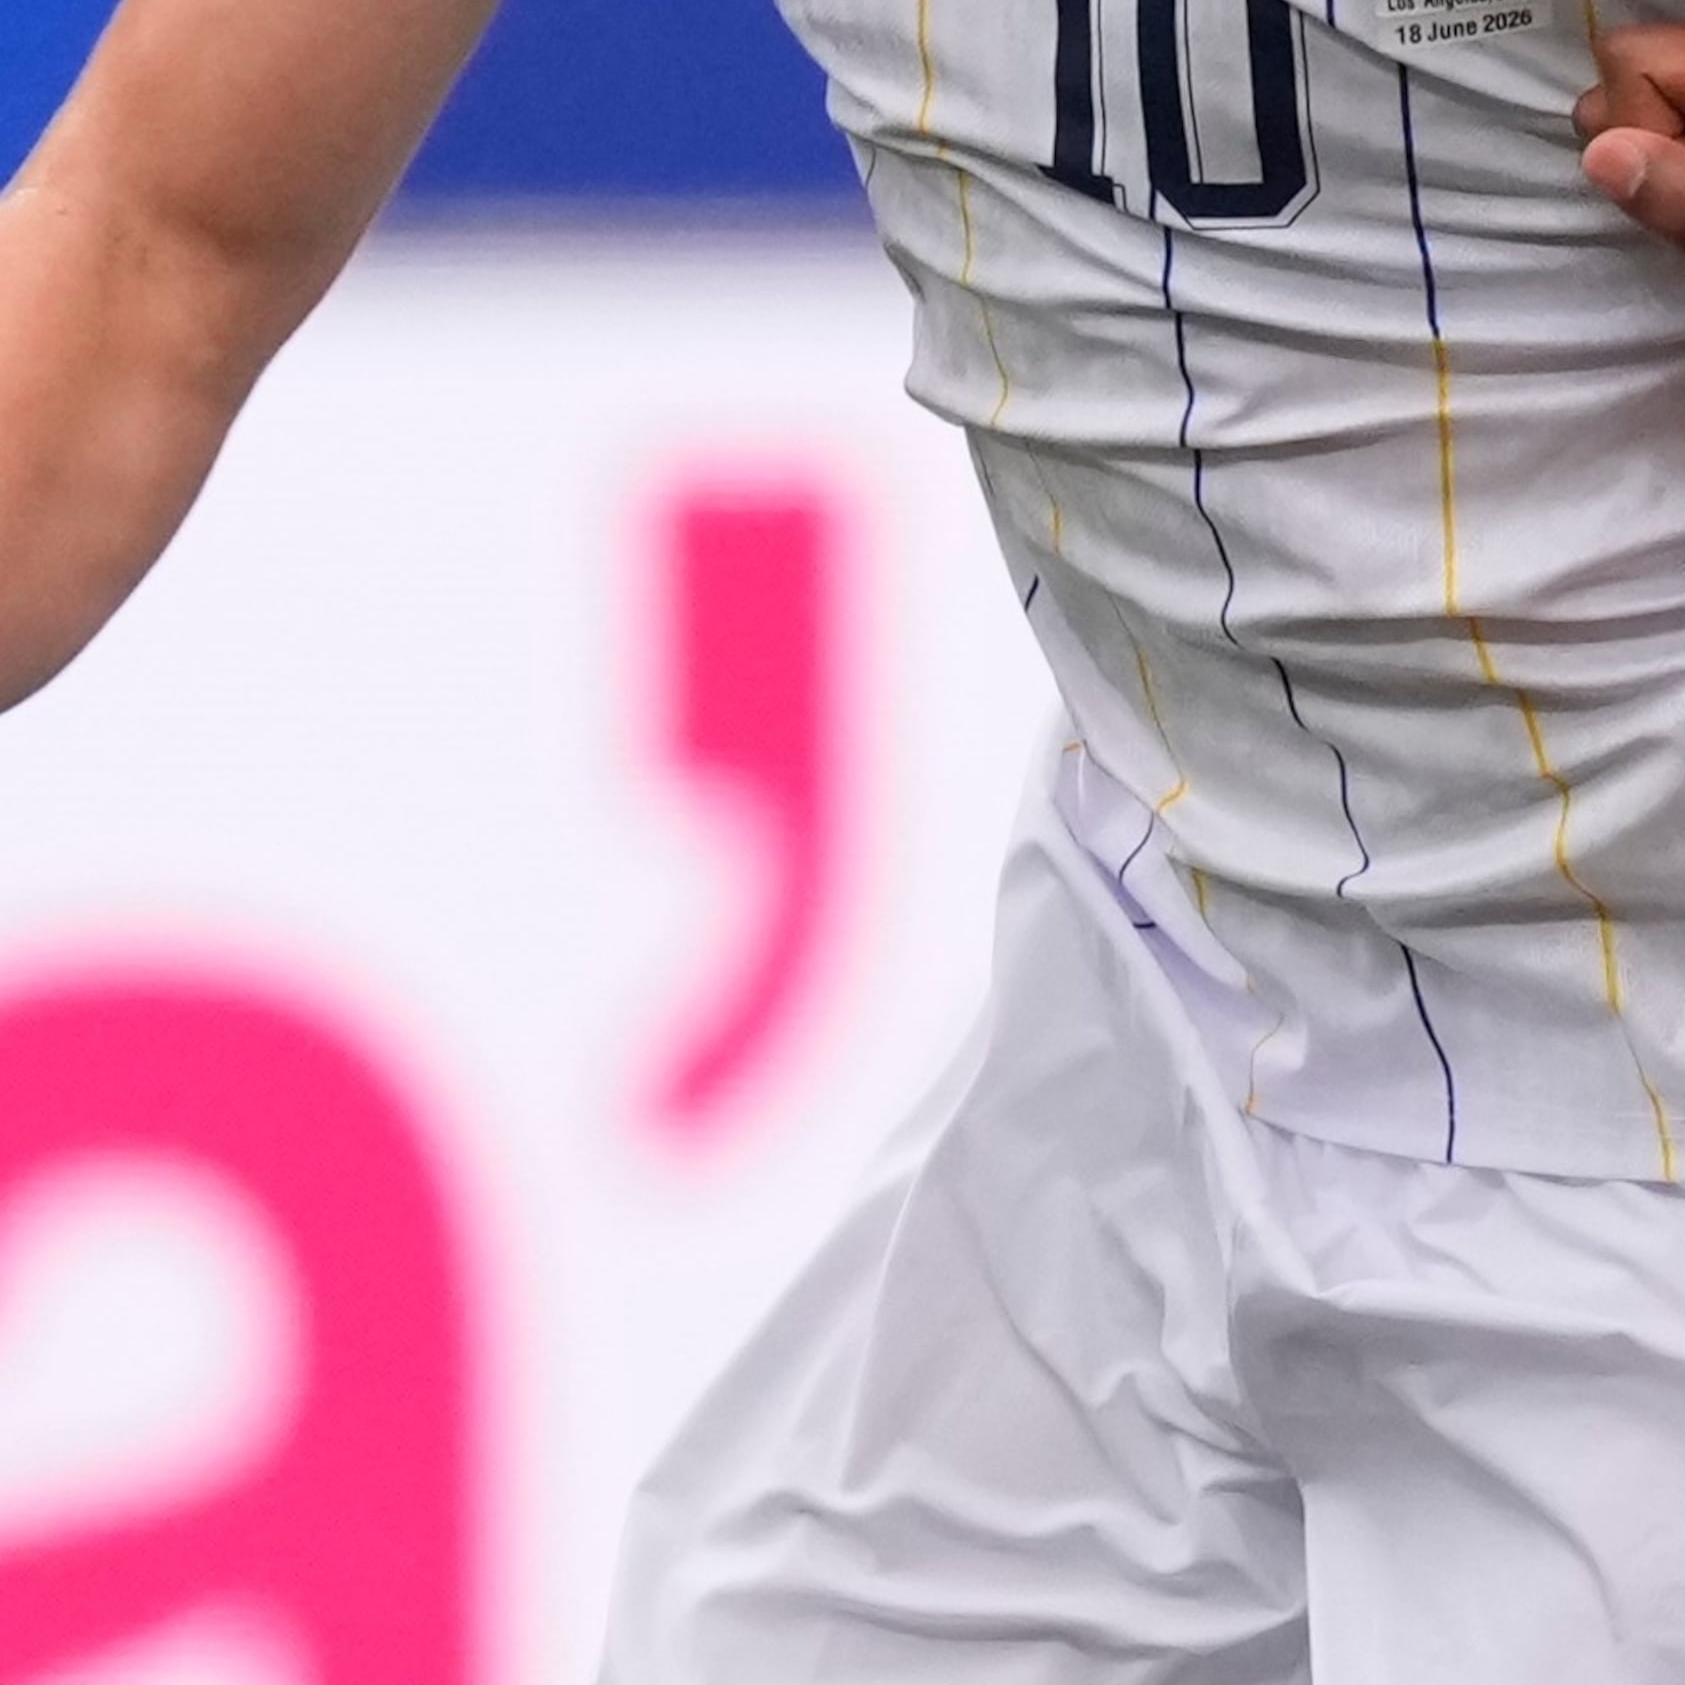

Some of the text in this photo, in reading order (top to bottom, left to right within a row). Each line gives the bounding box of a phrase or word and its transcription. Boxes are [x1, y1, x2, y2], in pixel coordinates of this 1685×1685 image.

[1396, 9, 1533, 45] 18 June 2026
